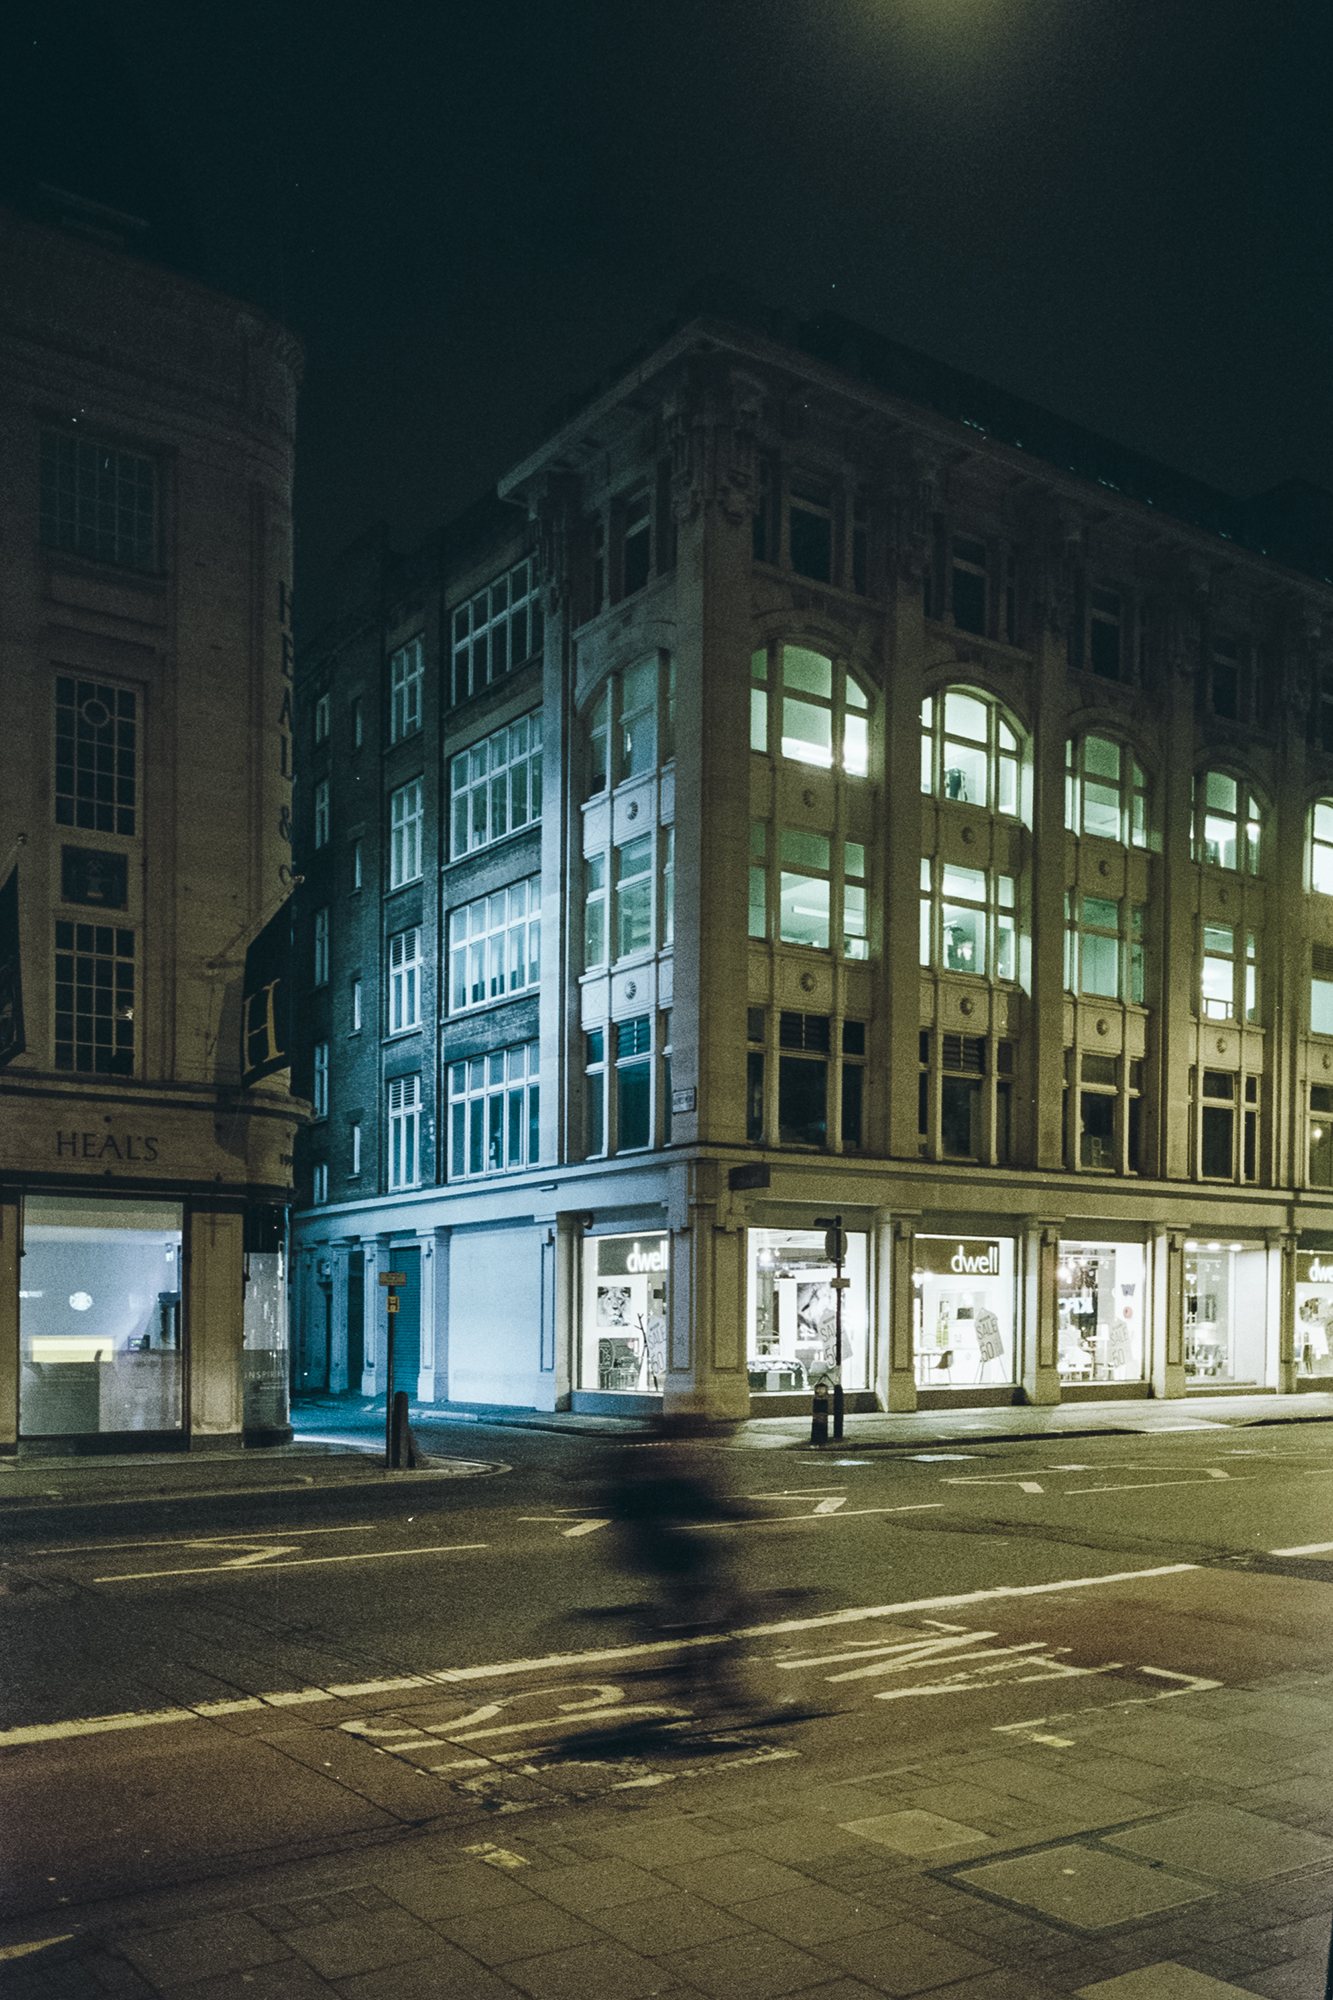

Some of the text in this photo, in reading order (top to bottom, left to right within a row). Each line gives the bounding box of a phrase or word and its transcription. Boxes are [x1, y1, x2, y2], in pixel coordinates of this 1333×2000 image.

[243, 977, 286, 1076] H
[57, 1131, 159, 1162] HEAL'S
[626, 1240, 669, 1273] dwell
[950, 1244, 998, 1275] dwell
[976, 1317, 998, 1340] SALE
[979, 1341, 996, 1363] 50
